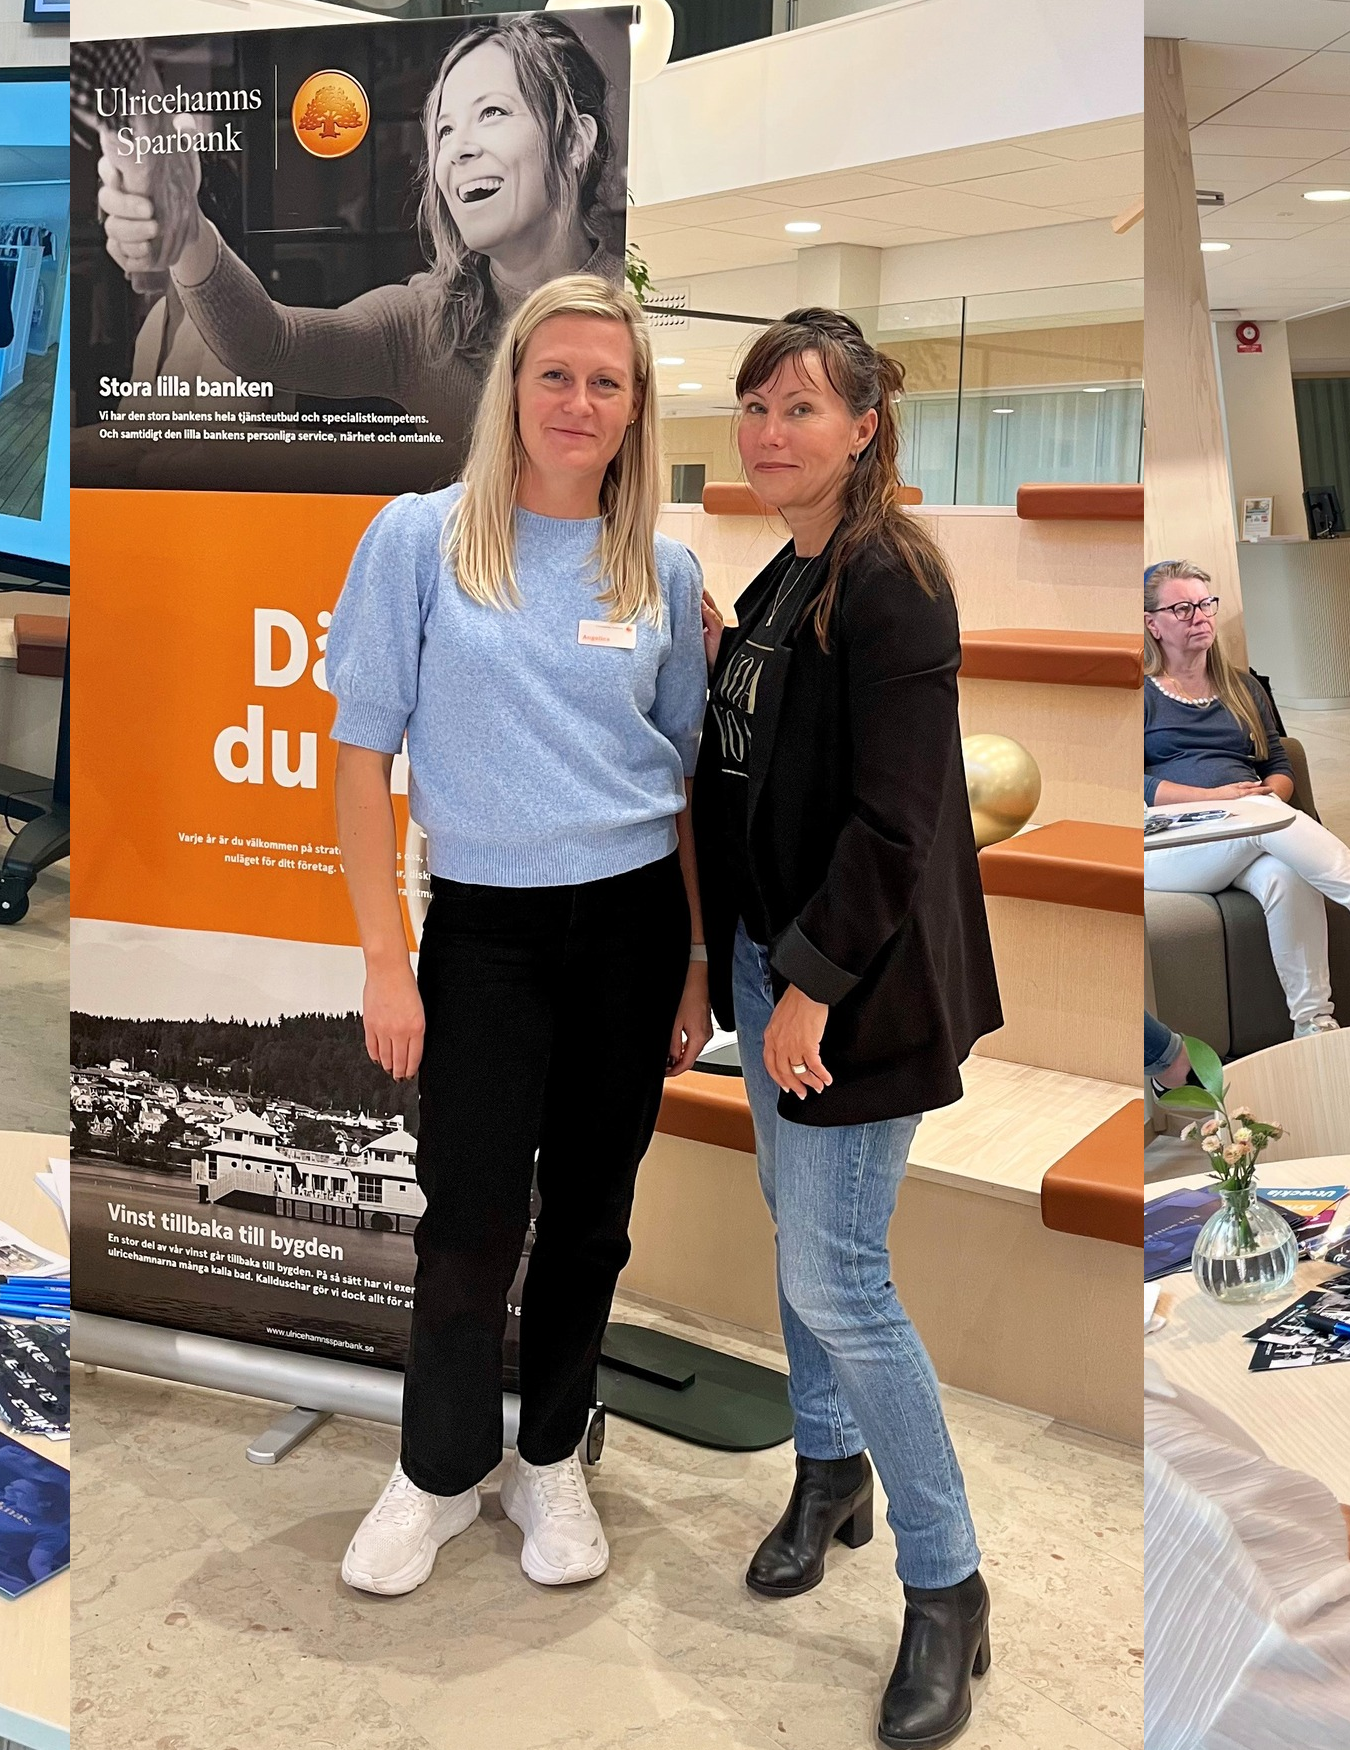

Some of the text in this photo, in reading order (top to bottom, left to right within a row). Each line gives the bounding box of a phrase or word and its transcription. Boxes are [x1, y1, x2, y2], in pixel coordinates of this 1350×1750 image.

[94, 84, 262, 117] Ulricehamns
[117, 122, 243, 164] Sparbank
[99, 375, 273, 397] Stora lilla banken
[98, 410, 429, 423] Vi har den stora bankens hela tjänsteutbud och specialistkompetens.
[99, 428, 443, 443] Och samtidigt den lilla bankens personliga service, närhet och omtanke.
[213, 704, 317, 789] du
[178, 832, 203, 844] Varje
[205, 835, 216, 843] år
[218, 835, 229, 844] är
[231, 836, 243, 846] du
[245, 839, 298, 851] välkommen
[301, 844, 312, 854] på
[224, 853, 336, 874] nuläget för ditt företag.
[107, 1202, 343, 1260] Vinst tillbaka till bygden
[108, 1232, 119, 1242] En
[120, 1236, 139, 1246] stor
[141, 1239, 155, 1249] del
[157, 1243, 167, 1251] av
[168, 1245, 183, 1254] vår
[185, 1248, 207, 1258] vinst
[209, 1251, 225, 1261] går
[227, 1253, 260, 1268] tillbaka
[261, 1260, 274, 1270] till
[277, 1262, 313, 1277] bygden.
[316, 1269, 327, 1280] På
[329, 1272, 340, 1282] så
[342, 1275, 361, 1286] sätt
[363, 1277, 381, 1288] har
[383, 1280, 391, 1290] vi
[108, 1248, 176, 1267] ulricehamnarna
[178, 1261, 209, 1274] många
[211, 1264, 232, 1276] kalla
[233, 1268, 253, 1281] bad.
[255, 1273, 311, 1291] Kallduschar
[312, 1285, 329, 1295] gör
[330, 1288, 339, 1296] vi
[341, 1289, 365, 1301] dock
[367, 1293, 384, 1304] allt
[386, 1295, 402, 1306] för
